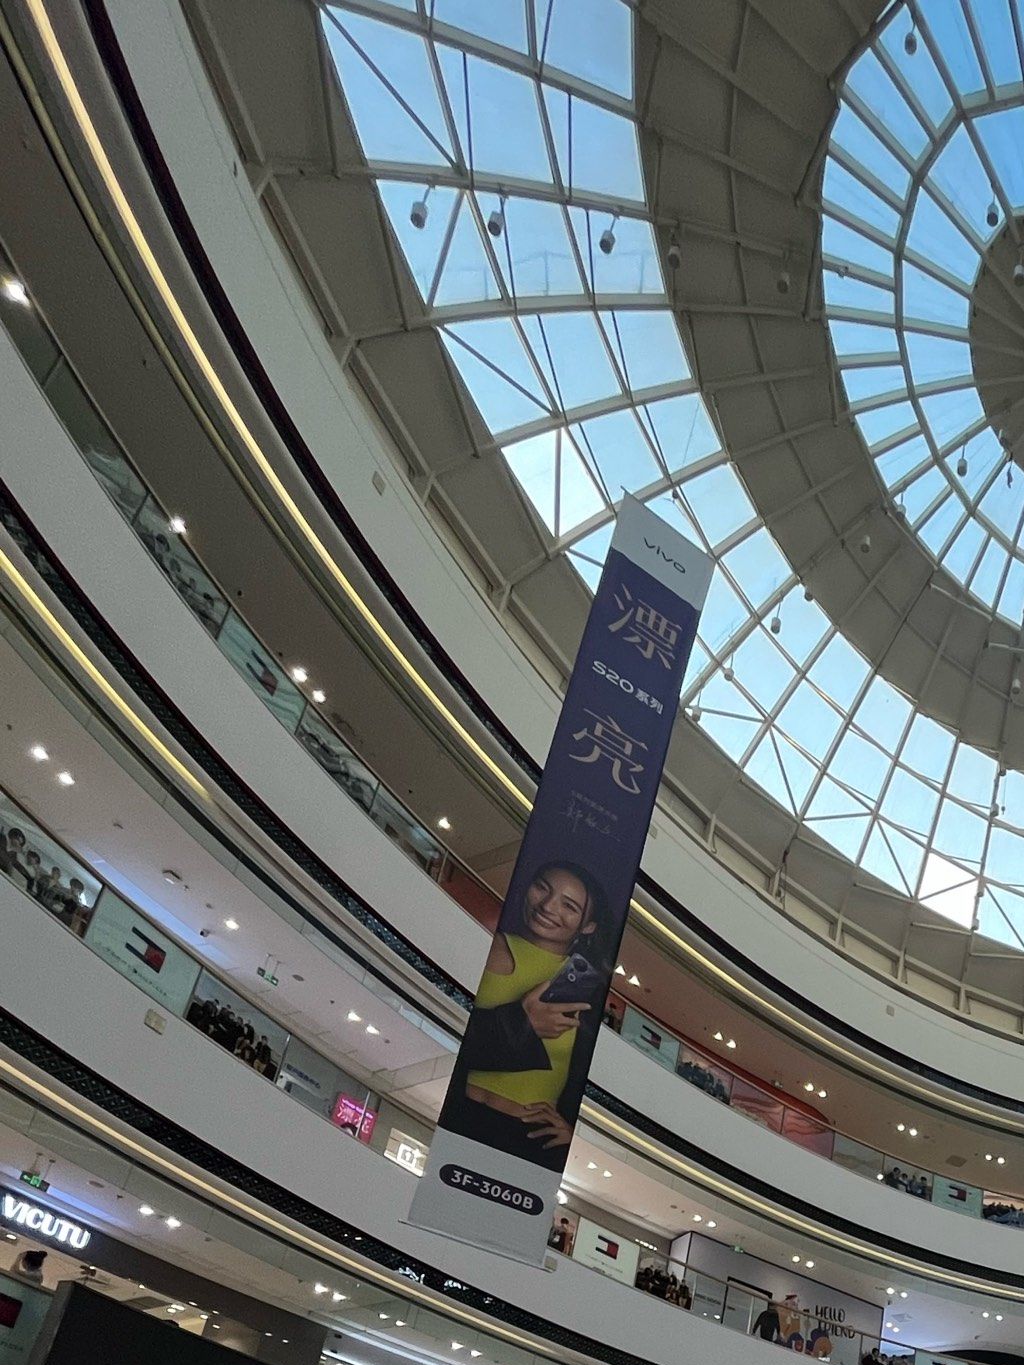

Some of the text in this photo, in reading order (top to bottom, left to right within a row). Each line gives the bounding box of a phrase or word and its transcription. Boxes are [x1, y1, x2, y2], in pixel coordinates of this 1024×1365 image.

[643, 536, 686, 574] vivo
[608, 583, 682, 670] 漂
[591, 660, 665, 716] S20 系列
[568, 708, 650, 795] 亮
[450, 1170, 535, 1211] 3F-3060B
[1, 1193, 91, 1250] VICUTU
[815, 1305, 845, 1323] HELLO
